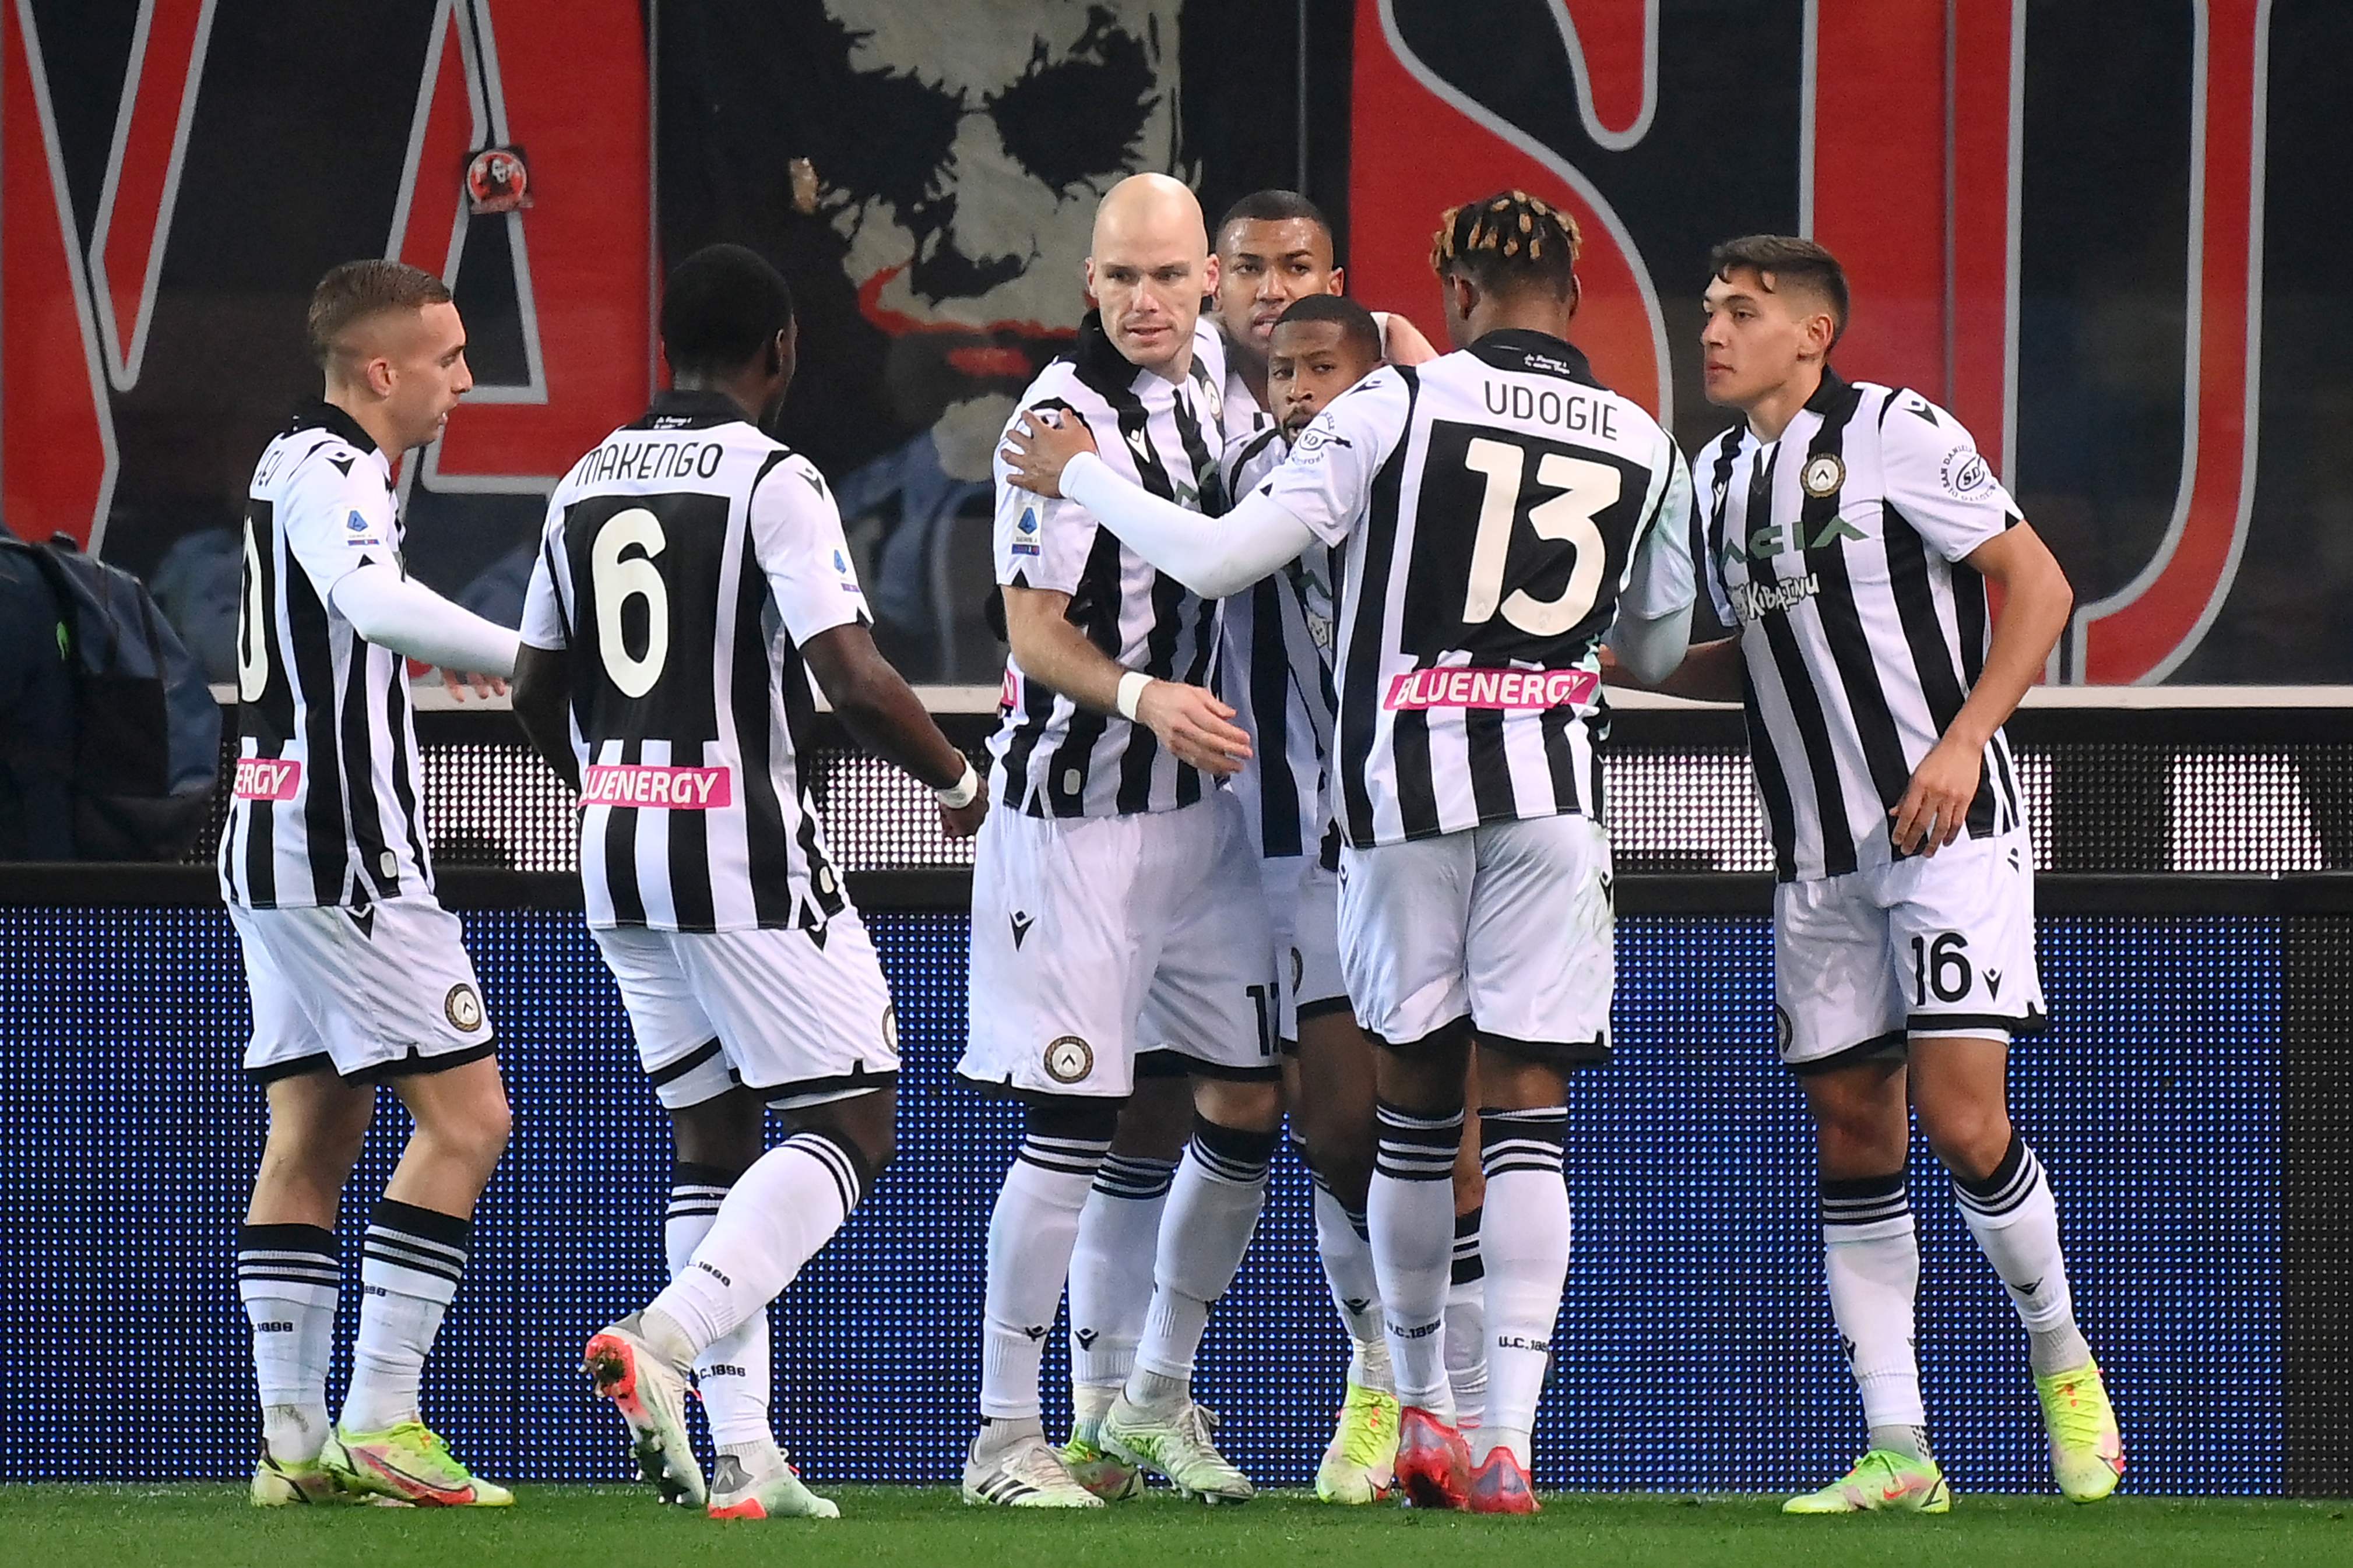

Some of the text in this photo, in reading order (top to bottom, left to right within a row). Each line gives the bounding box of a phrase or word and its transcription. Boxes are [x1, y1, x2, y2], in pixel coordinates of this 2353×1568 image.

[1485, 380, 1617, 441] UDOGIE
[575, 442, 723, 487] MAKENGO
[1963, 467, 1981, 485] SD
[1462, 438, 1621, 636] 13
[592, 508, 669, 698] 6
[1394, 671, 1588, 706] BLUENERGY
[581, 770, 718, 804] LUENERGY
[1912, 933, 1972, 1006] 16
